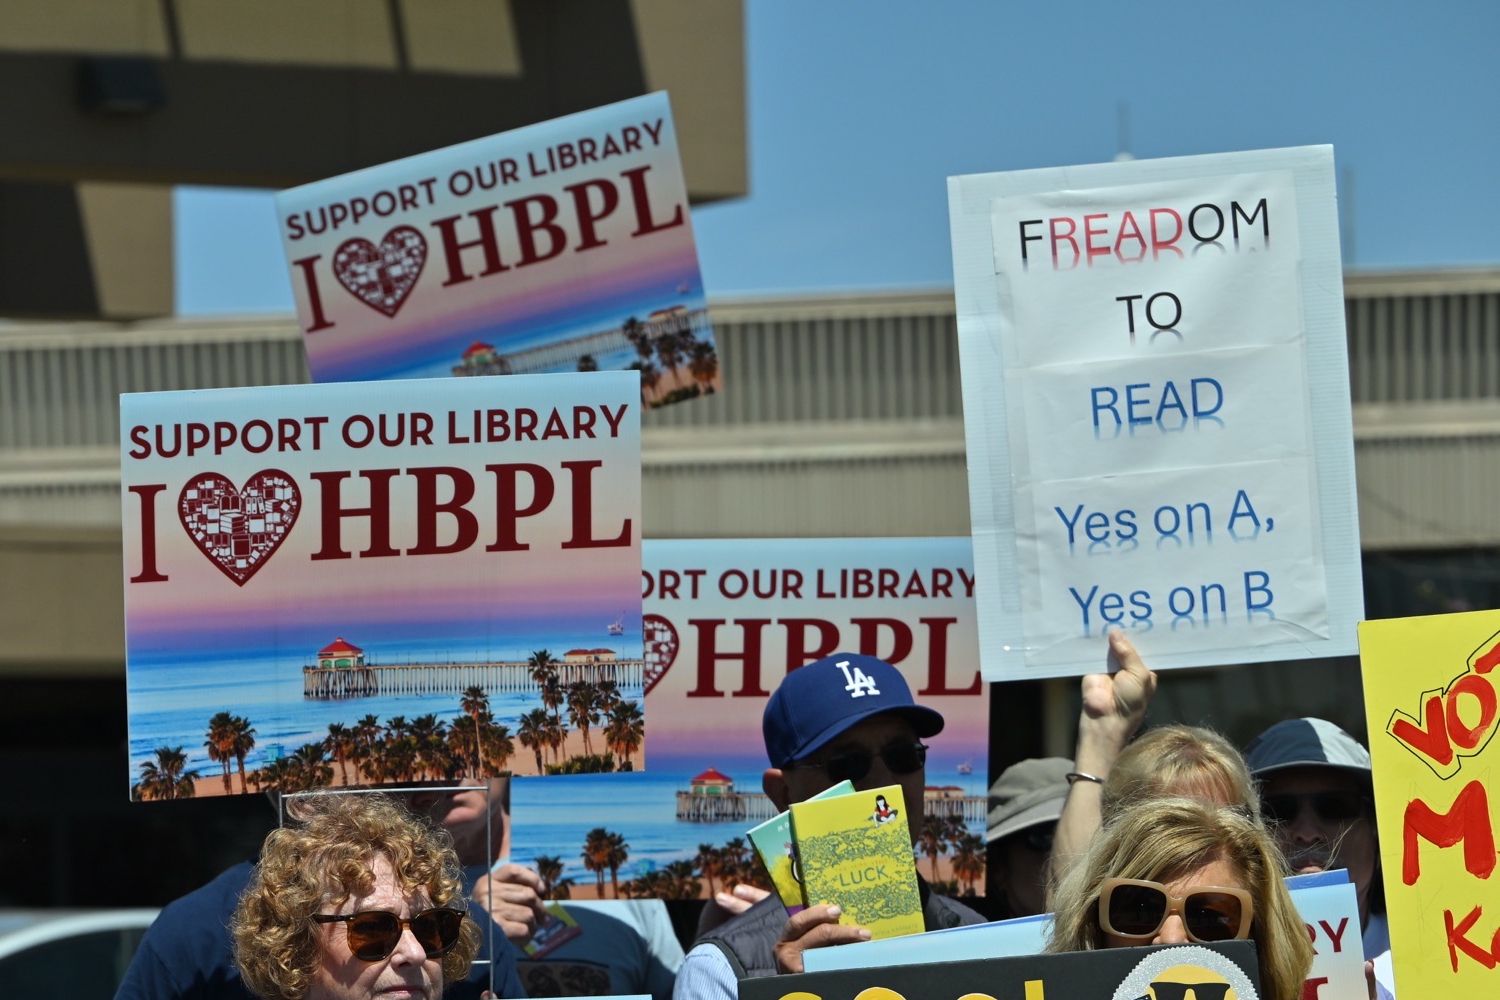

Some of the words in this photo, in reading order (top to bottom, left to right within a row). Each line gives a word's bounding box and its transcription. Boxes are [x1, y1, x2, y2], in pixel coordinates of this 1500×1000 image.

[286, 179, 438, 241] SUPPORT
[448, 159, 519, 197] OUR
[527, 119, 664, 178] LIBRARY
[293, 255, 335, 334] I
[431, 165, 684, 287] HBPL
[1018, 197, 1270, 262] FREADOM
[1116, 292, 1183, 334] TO
[1090, 377, 1224, 428] READ
[128, 416, 329, 460] SUPPORT
[342, 413, 434, 449] OUR
[447, 404, 629, 445] LIBRARY
[128, 483, 169, 584] I
[310, 459, 632, 561] HBPL
[1054, 503, 1139, 545] Yes
[1153, 500, 1212, 536] on
[1227, 490, 1275, 533] A,
[719, 568, 803, 600] OUR
[816, 567, 975, 600] LIBRARY
[1069, 585, 1153, 626] Yes
[1167, 583, 1226, 617] on
[1244, 570, 1274, 611] B
[836, 661, 882, 698] LA
[838, 864, 889, 887] LUCK
